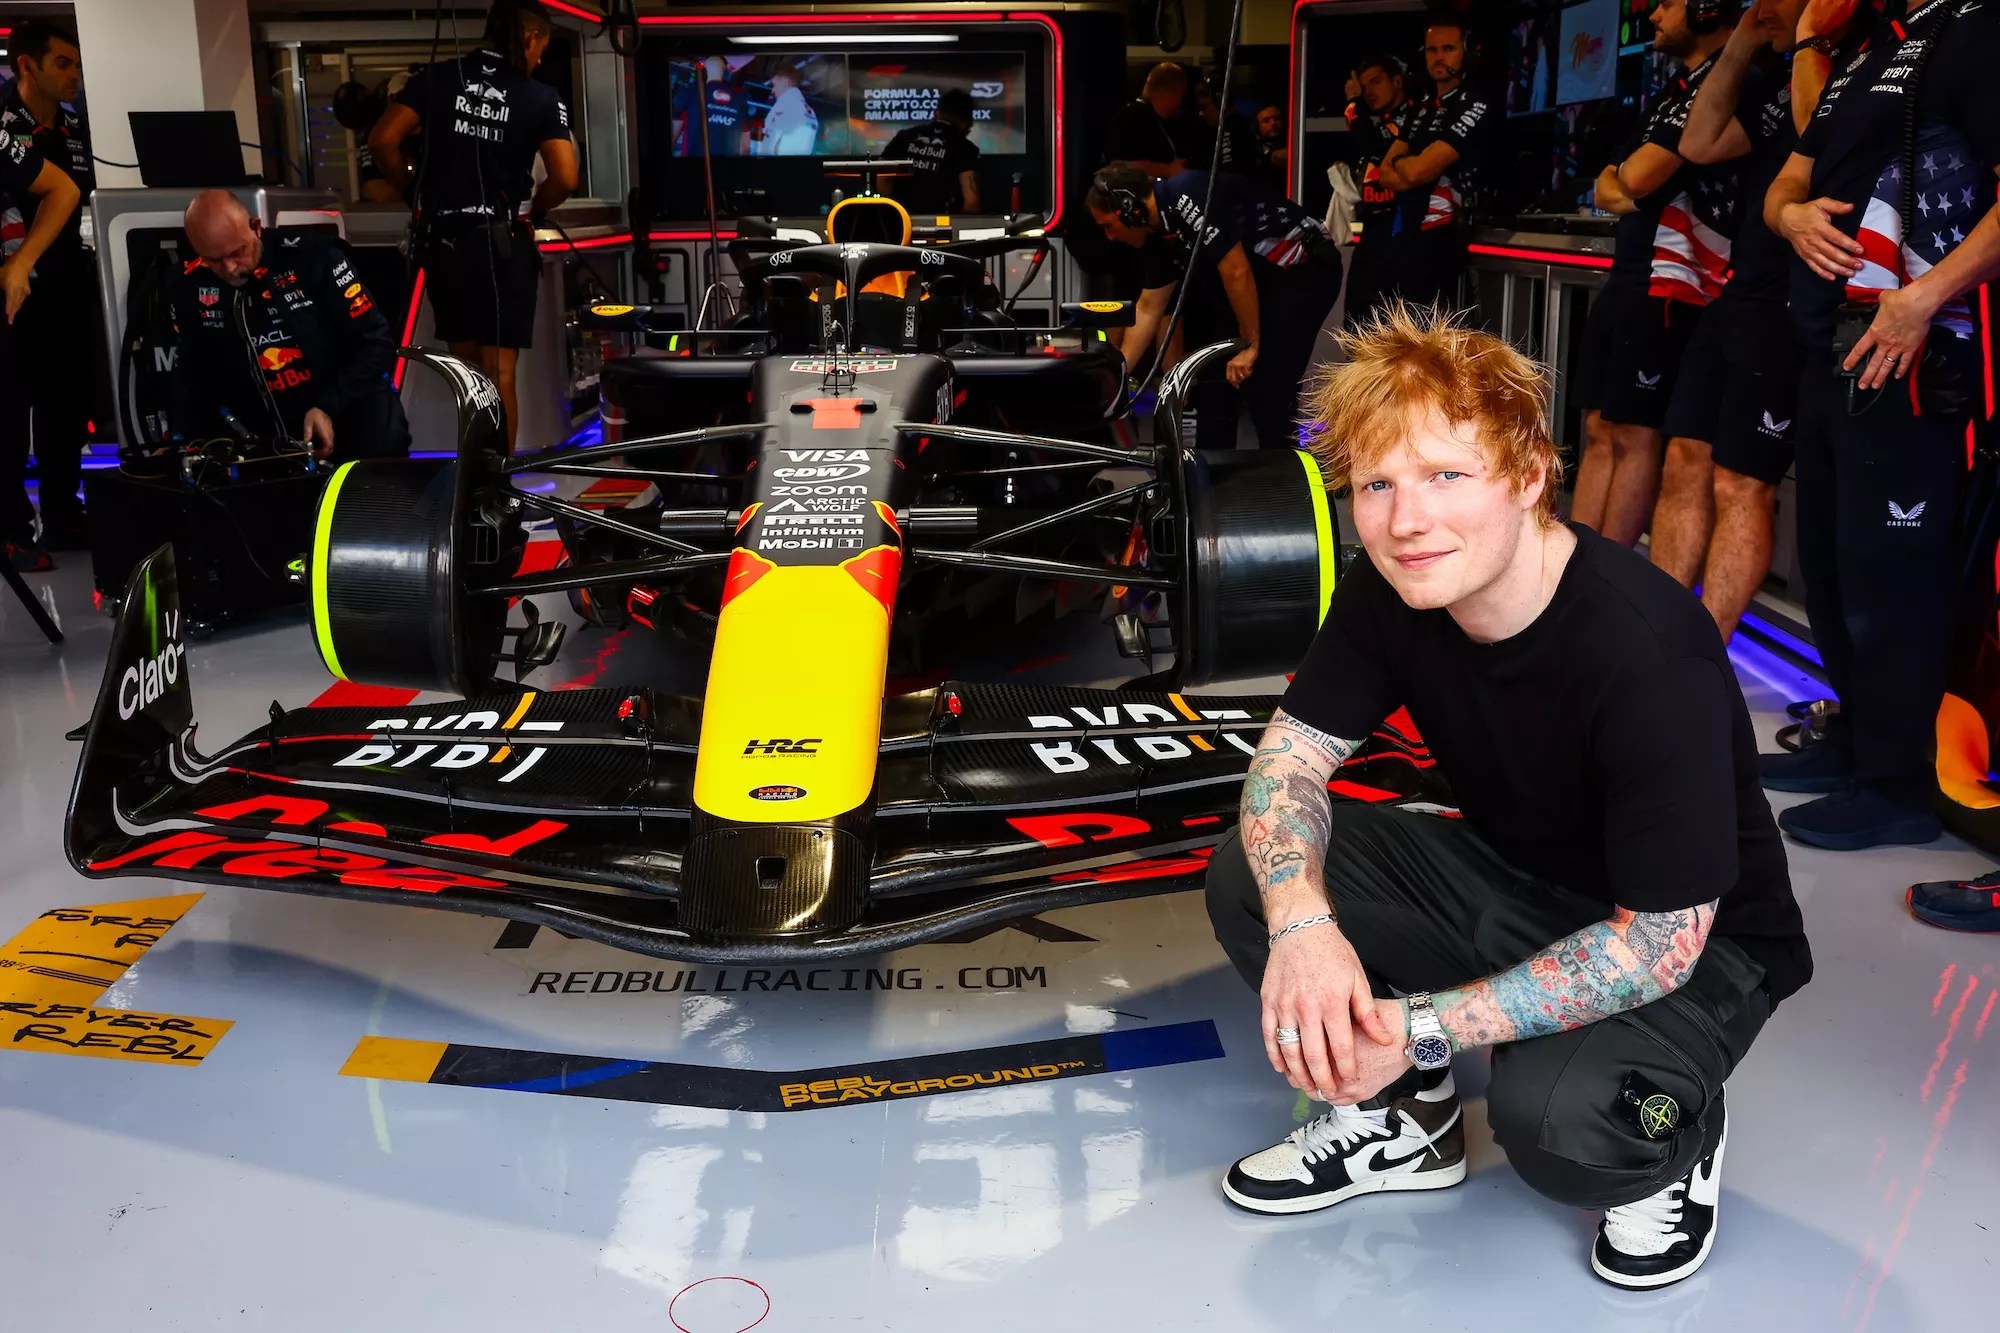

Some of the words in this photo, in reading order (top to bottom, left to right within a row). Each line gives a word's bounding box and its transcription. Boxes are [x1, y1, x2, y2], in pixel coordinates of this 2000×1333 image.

[1881, 65, 1913, 80] BYBIT
[864, 88, 931, 99] FORMULA
[932, 88, 940, 98] 1
[1869, 84, 1904, 94] HONDA
[864, 110, 909, 120] MIAMI
[910, 110, 936, 120] GRA
[779, 251, 793, 264] Sui
[931, 252, 945, 266] Sui
[779, 450, 871, 462] VISA
[770, 485, 868, 496] zoom
[804, 497, 866, 505] ARCTIC
[811, 504, 861, 512] WOLF
[763, 514, 865, 525] PIRELLI
[761, 527, 864, 537] infinitum
[758, 538, 833, 550] Mobil
[119, 643, 178, 720] Claro
[743, 738, 823, 755] HRC
[528, 965, 1048, 995] REDBULLRACING.COM
[13, 1023, 204, 1060] REBL
[779, 1075, 893, 1097] REBL
